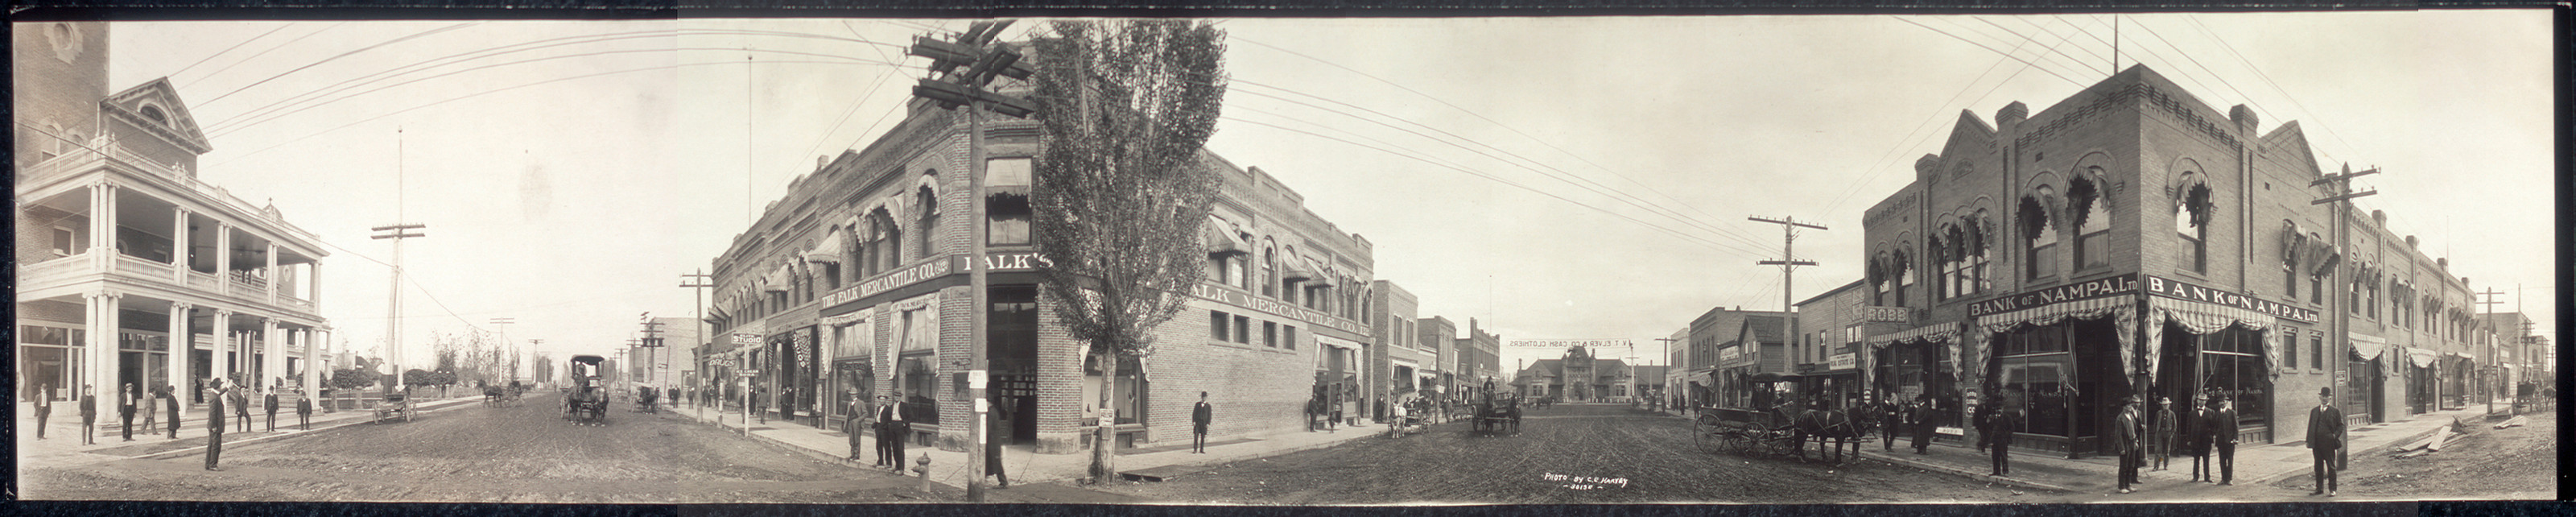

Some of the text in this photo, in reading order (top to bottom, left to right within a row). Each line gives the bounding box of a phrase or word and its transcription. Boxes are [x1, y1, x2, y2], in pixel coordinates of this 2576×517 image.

[822, 295, 836, 308] THE
[838, 286, 859, 304] FALK
[861, 267, 918, 297] MERCANTILE
[919, 263, 935, 279] CO.
[2149, 276, 2226, 304] BANK
[2227, 295, 2239, 305] OF
[1192, 283, 1231, 304] ALK
[1243, 295, 1335, 328] MERCANTILE
[1341, 321, 1357, 333] CO.
[1868, 308, 1906, 321] ROBB
[1971, 296, 2016, 316] BANK
[2021, 295, 2034, 306] OF
[733, 335, 762, 343] STUDIO
[708, 358, 736, 367] DRUGS
